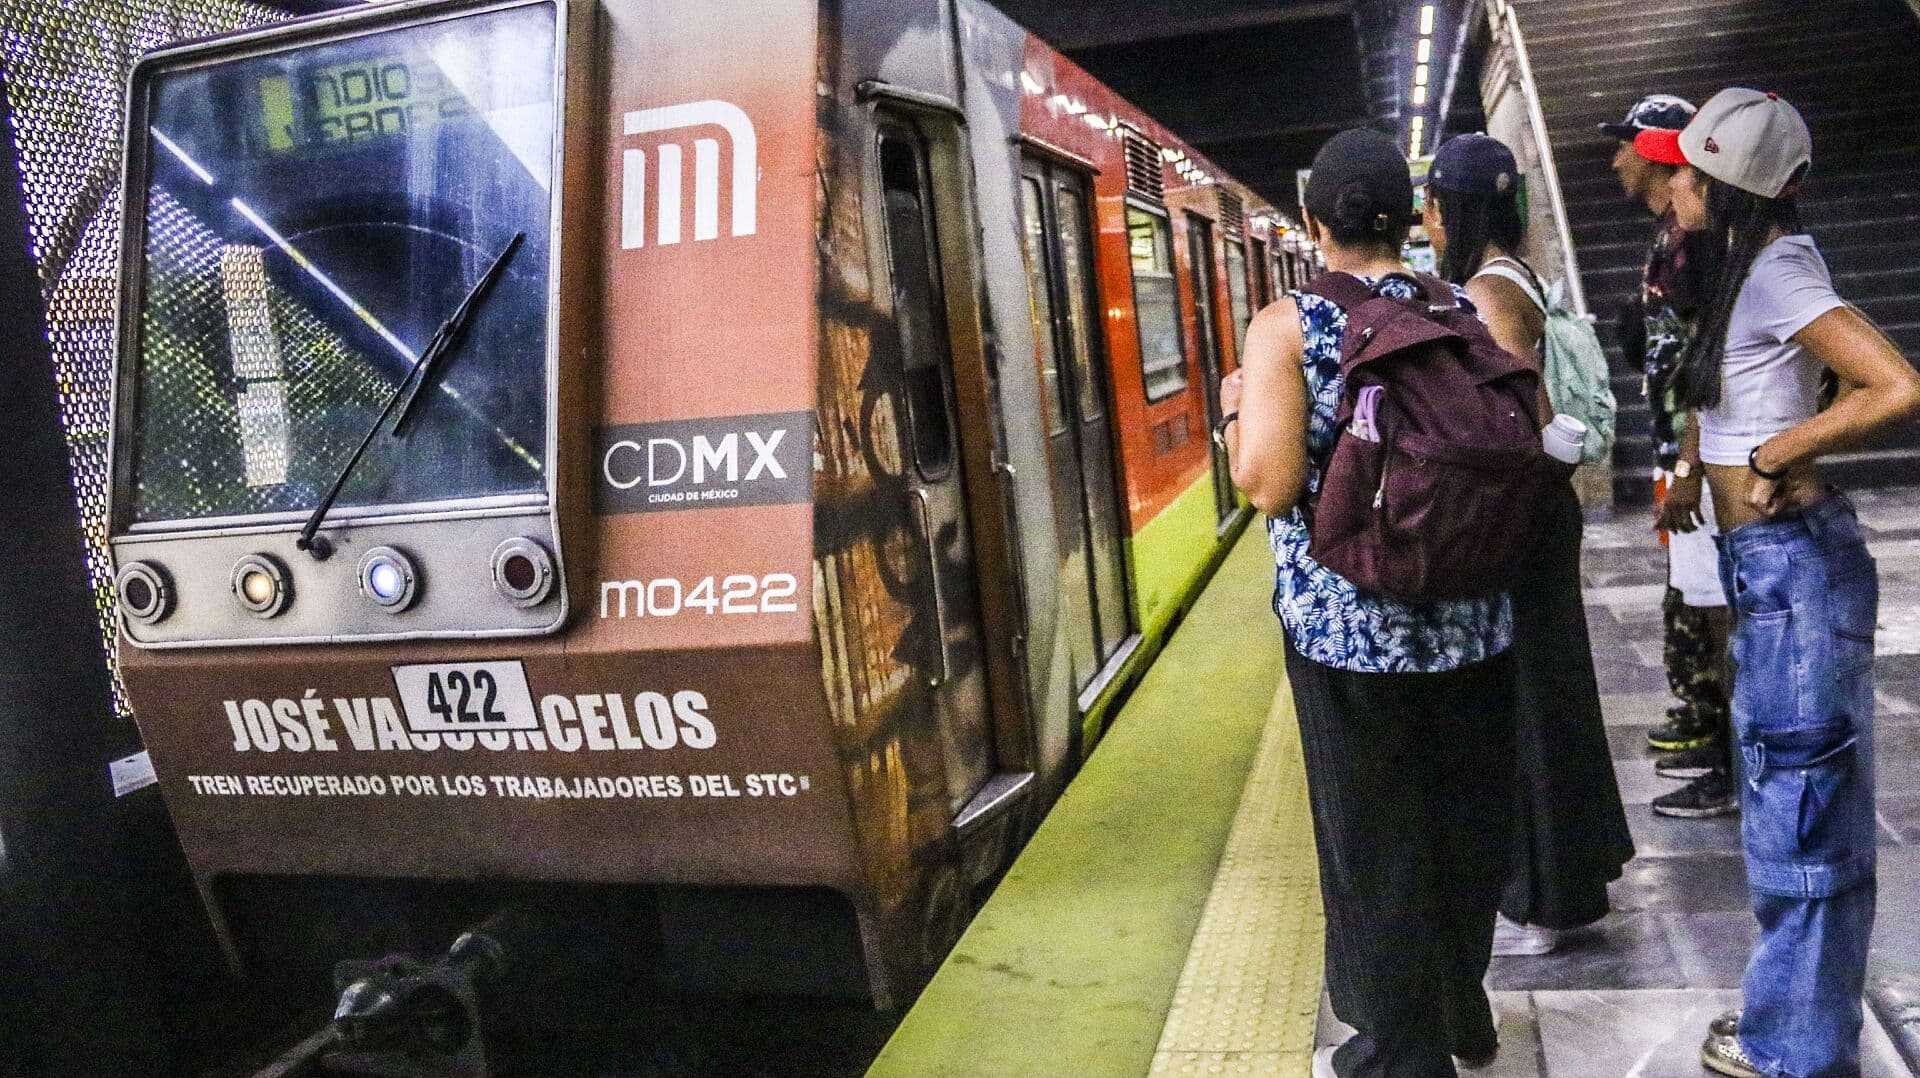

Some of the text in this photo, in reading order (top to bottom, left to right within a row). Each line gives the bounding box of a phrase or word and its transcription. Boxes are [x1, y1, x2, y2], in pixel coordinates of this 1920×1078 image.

[603, 429, 788, 489] CDMX
[648, 488, 739, 503] CIUDAD DE MÉXICO
[223, 688, 339, 752] JOSÉ
[427, 669, 507, 723] 422
[188, 773, 799, 799] TREN RECUPERADO POR LOS TRABAJADORES DEL STC
